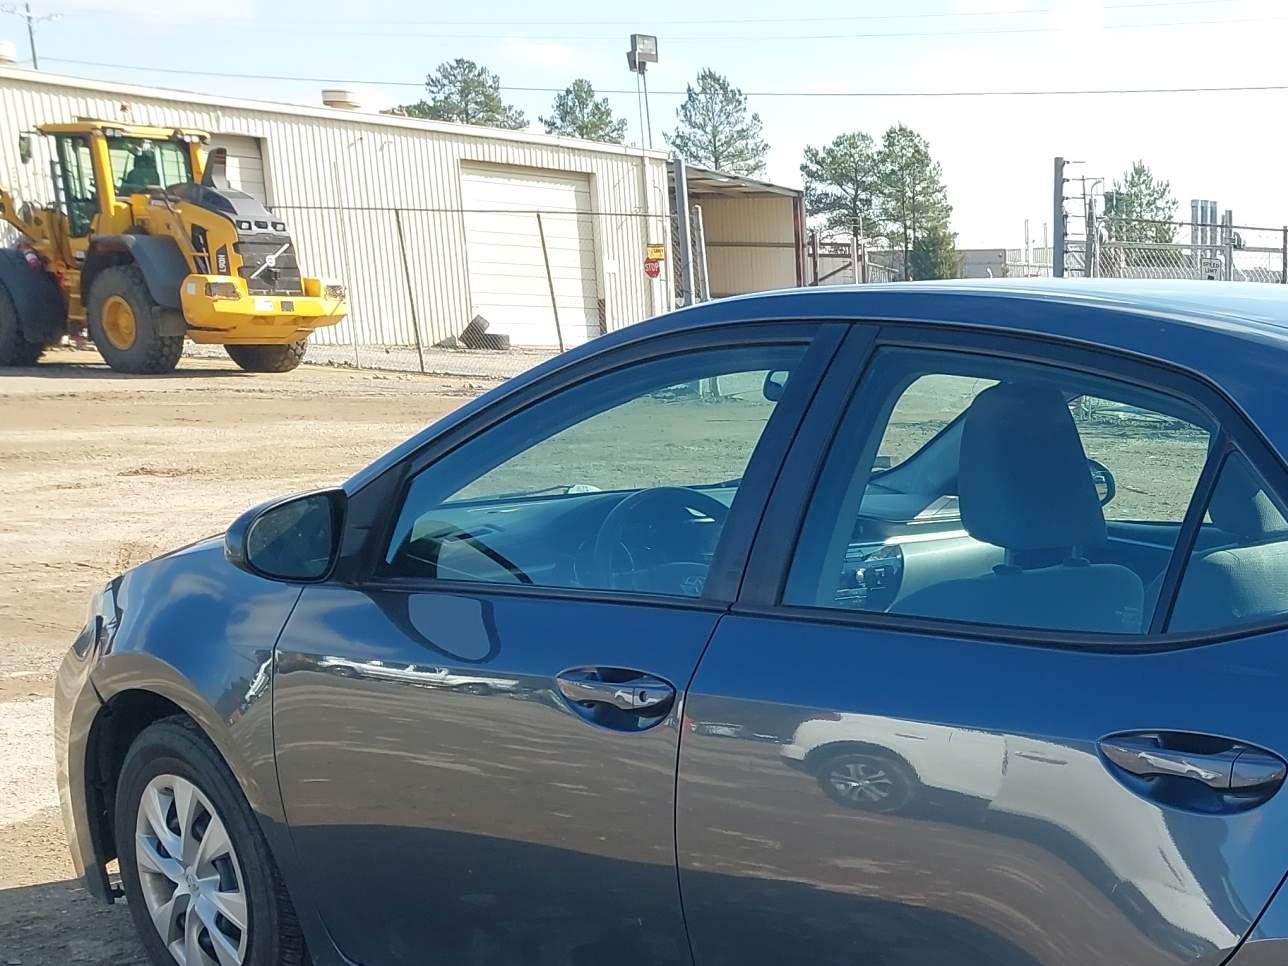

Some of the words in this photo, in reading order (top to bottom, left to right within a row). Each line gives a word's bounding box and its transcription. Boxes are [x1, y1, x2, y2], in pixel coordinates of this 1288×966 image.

[644, 262, 660, 272] STOP
[1202, 261, 1220, 269] SPEED
[1204, 267, 1218, 275] LIMIT
